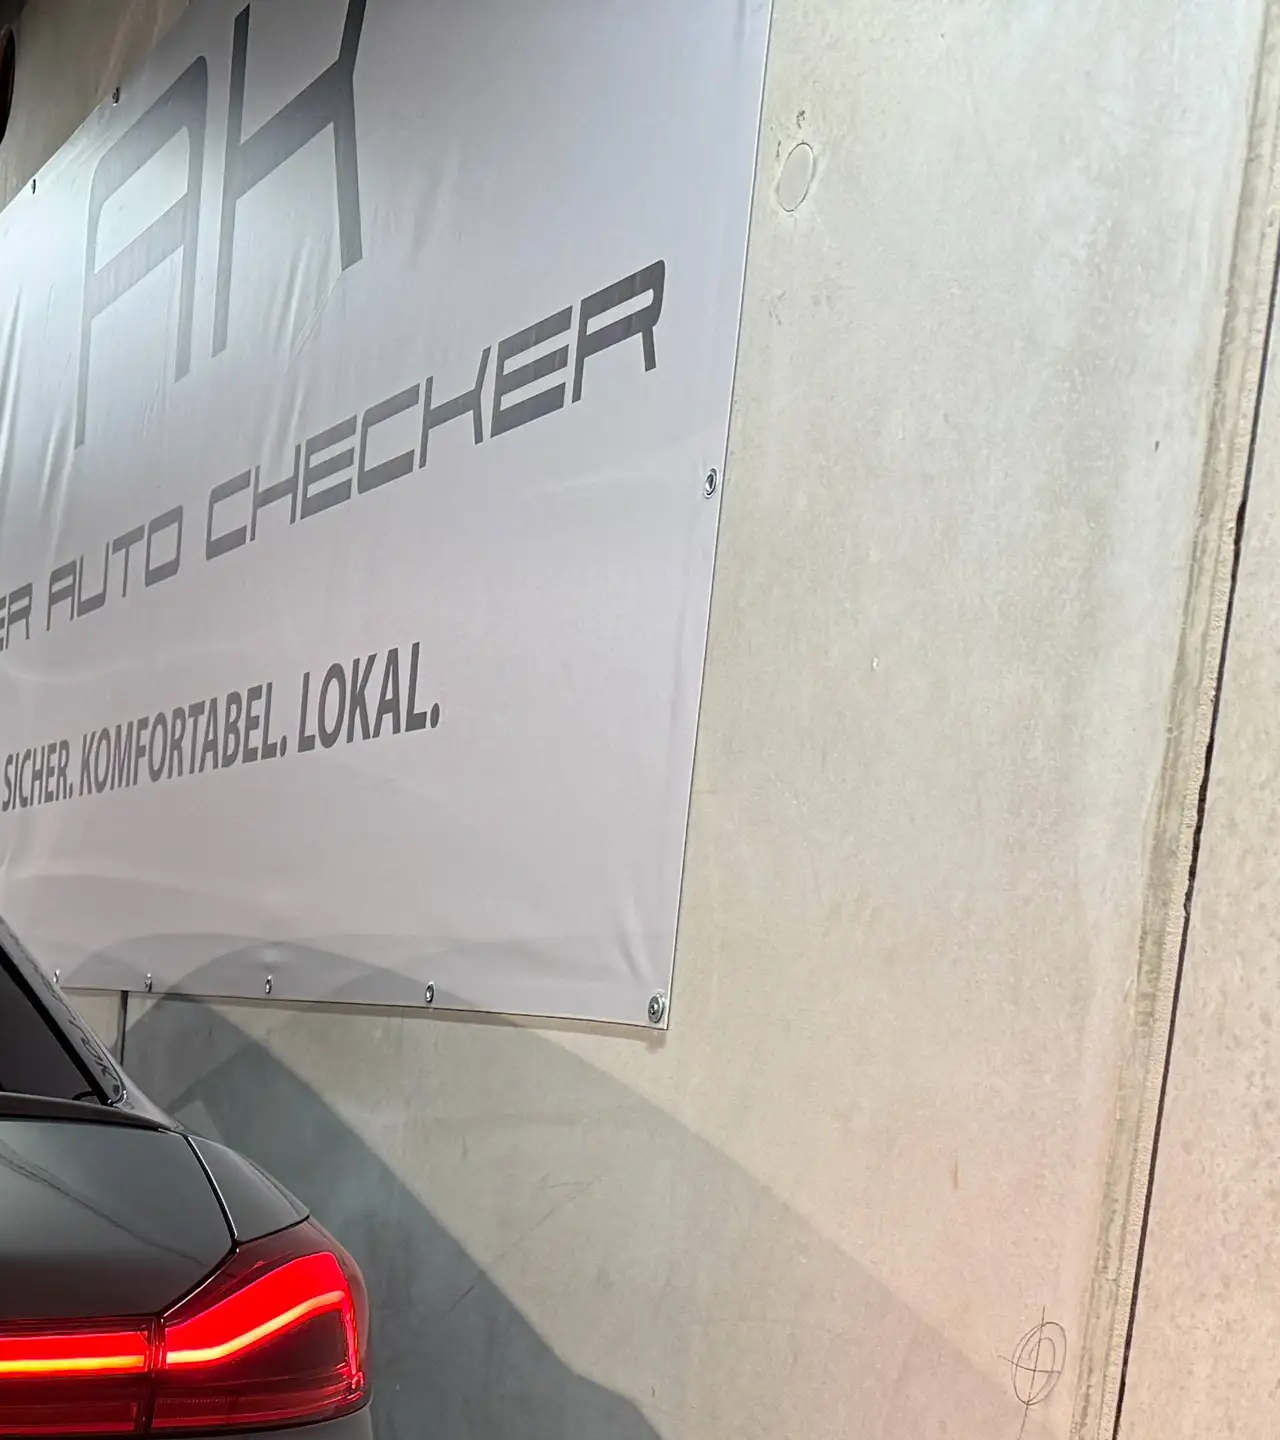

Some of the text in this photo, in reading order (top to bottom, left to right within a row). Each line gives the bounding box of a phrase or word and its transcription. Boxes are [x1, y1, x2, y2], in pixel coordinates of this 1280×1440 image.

[74, 0, 364, 448] AK
[47, 505, 184, 632] AUTO
[206, 259, 666, 561] CHECKER
[1, 641, 441, 813] SICHER. KOMFORTABEL. LOKAL.
